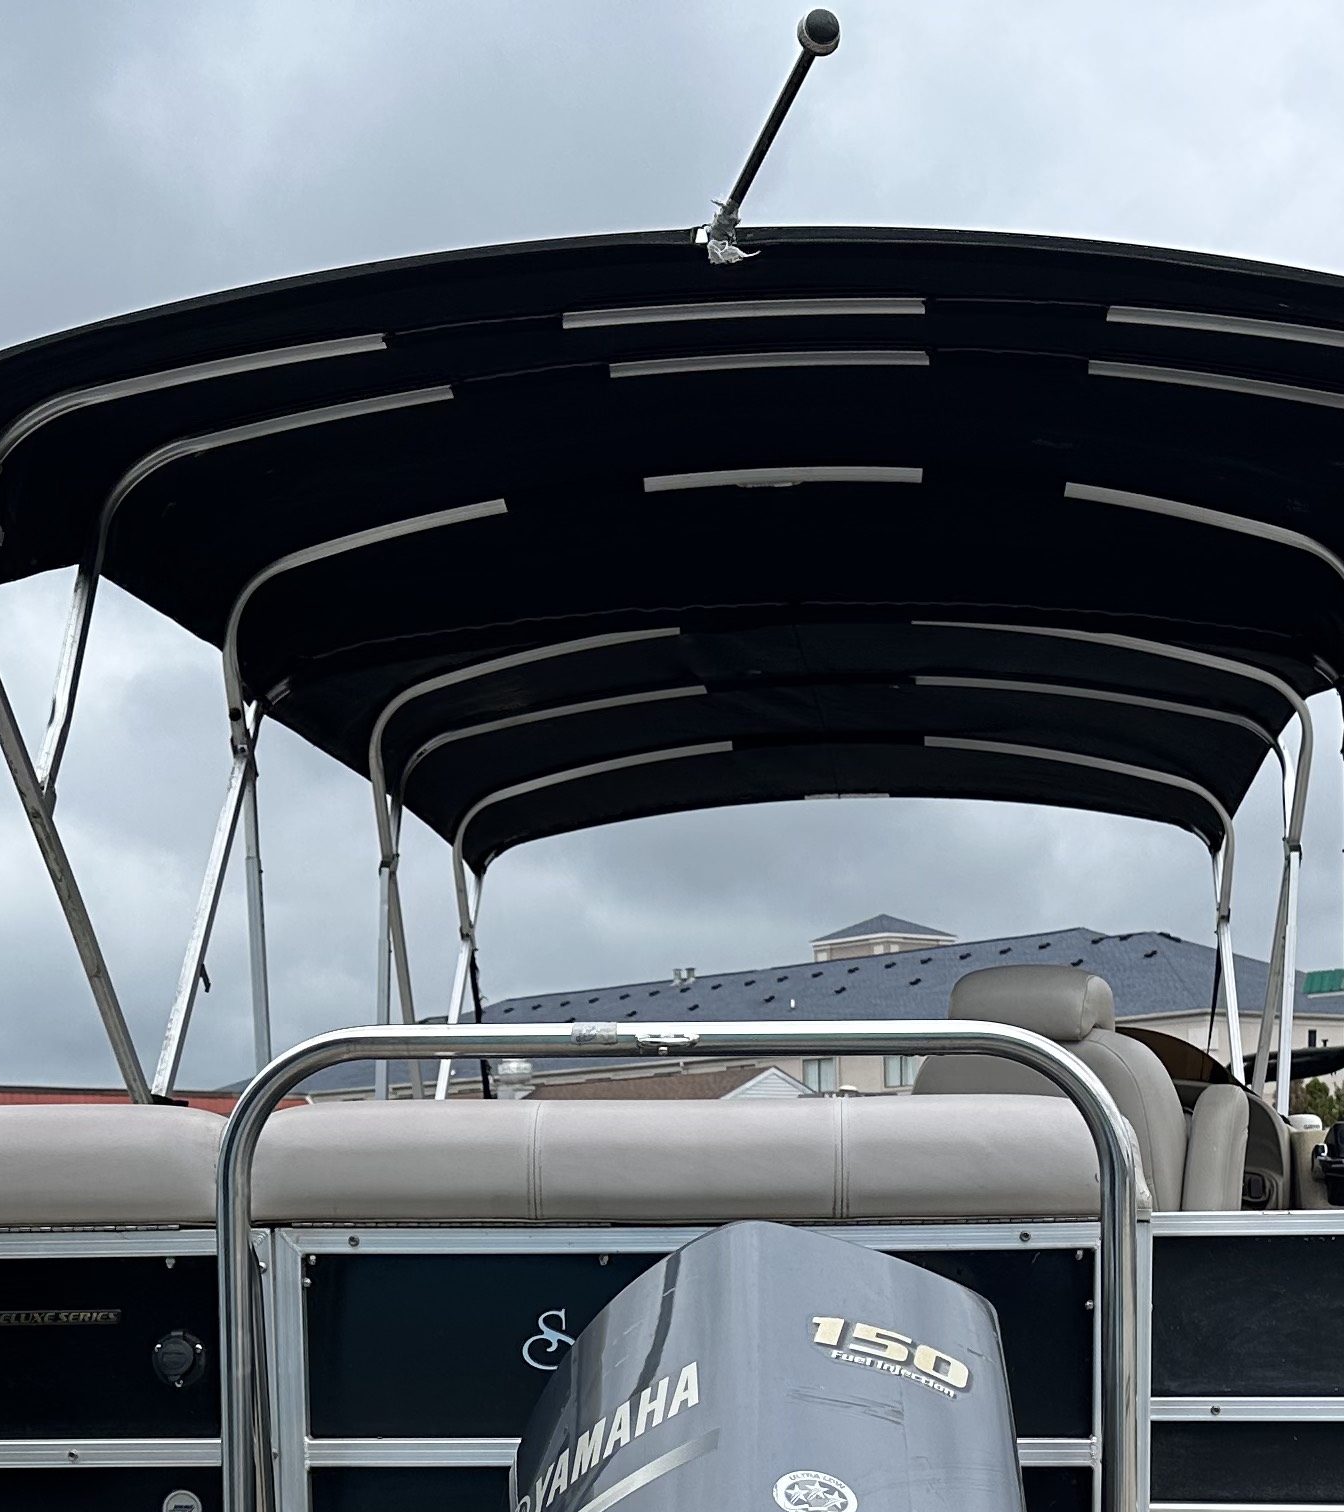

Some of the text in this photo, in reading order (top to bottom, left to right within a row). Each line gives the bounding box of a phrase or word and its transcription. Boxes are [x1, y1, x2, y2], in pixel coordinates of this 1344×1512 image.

[57, 1311, 118, 1323] SERIES
[812, 1316, 969, 1389] 150
[830, 1349, 957, 1398] Fuel Injection
[789, 1472, 845, 1489] ULTRA LOW
